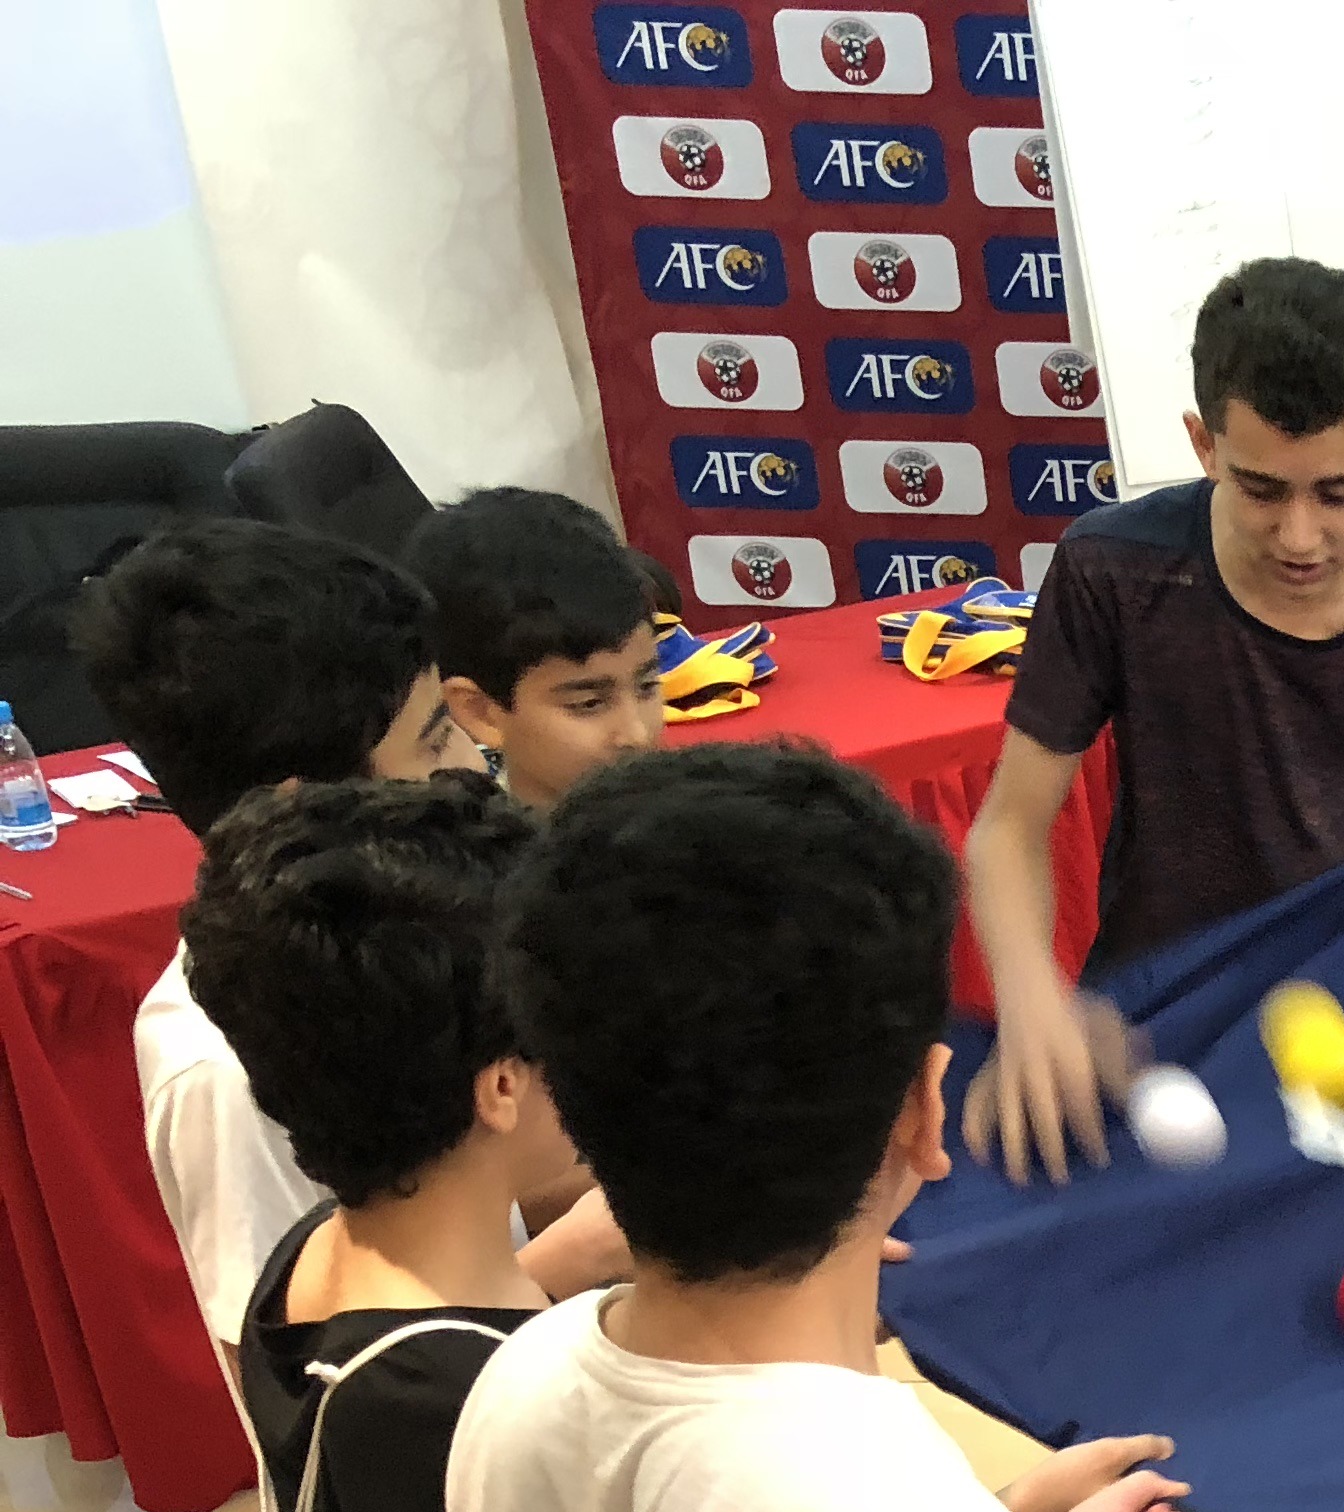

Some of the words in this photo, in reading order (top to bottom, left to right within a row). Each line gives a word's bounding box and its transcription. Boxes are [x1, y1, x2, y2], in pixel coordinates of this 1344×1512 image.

[616, 21, 719, 71] AFC
[976, 32, 1035, 81] AF
[814, 139, 915, 188] AFC
[656, 242, 755, 290] AFC
[1003, 252, 1061, 298] AF
[846, 354, 942, 399] AFC
[692, 451, 788, 495] AFC
[875, 554, 957, 596] AFC
